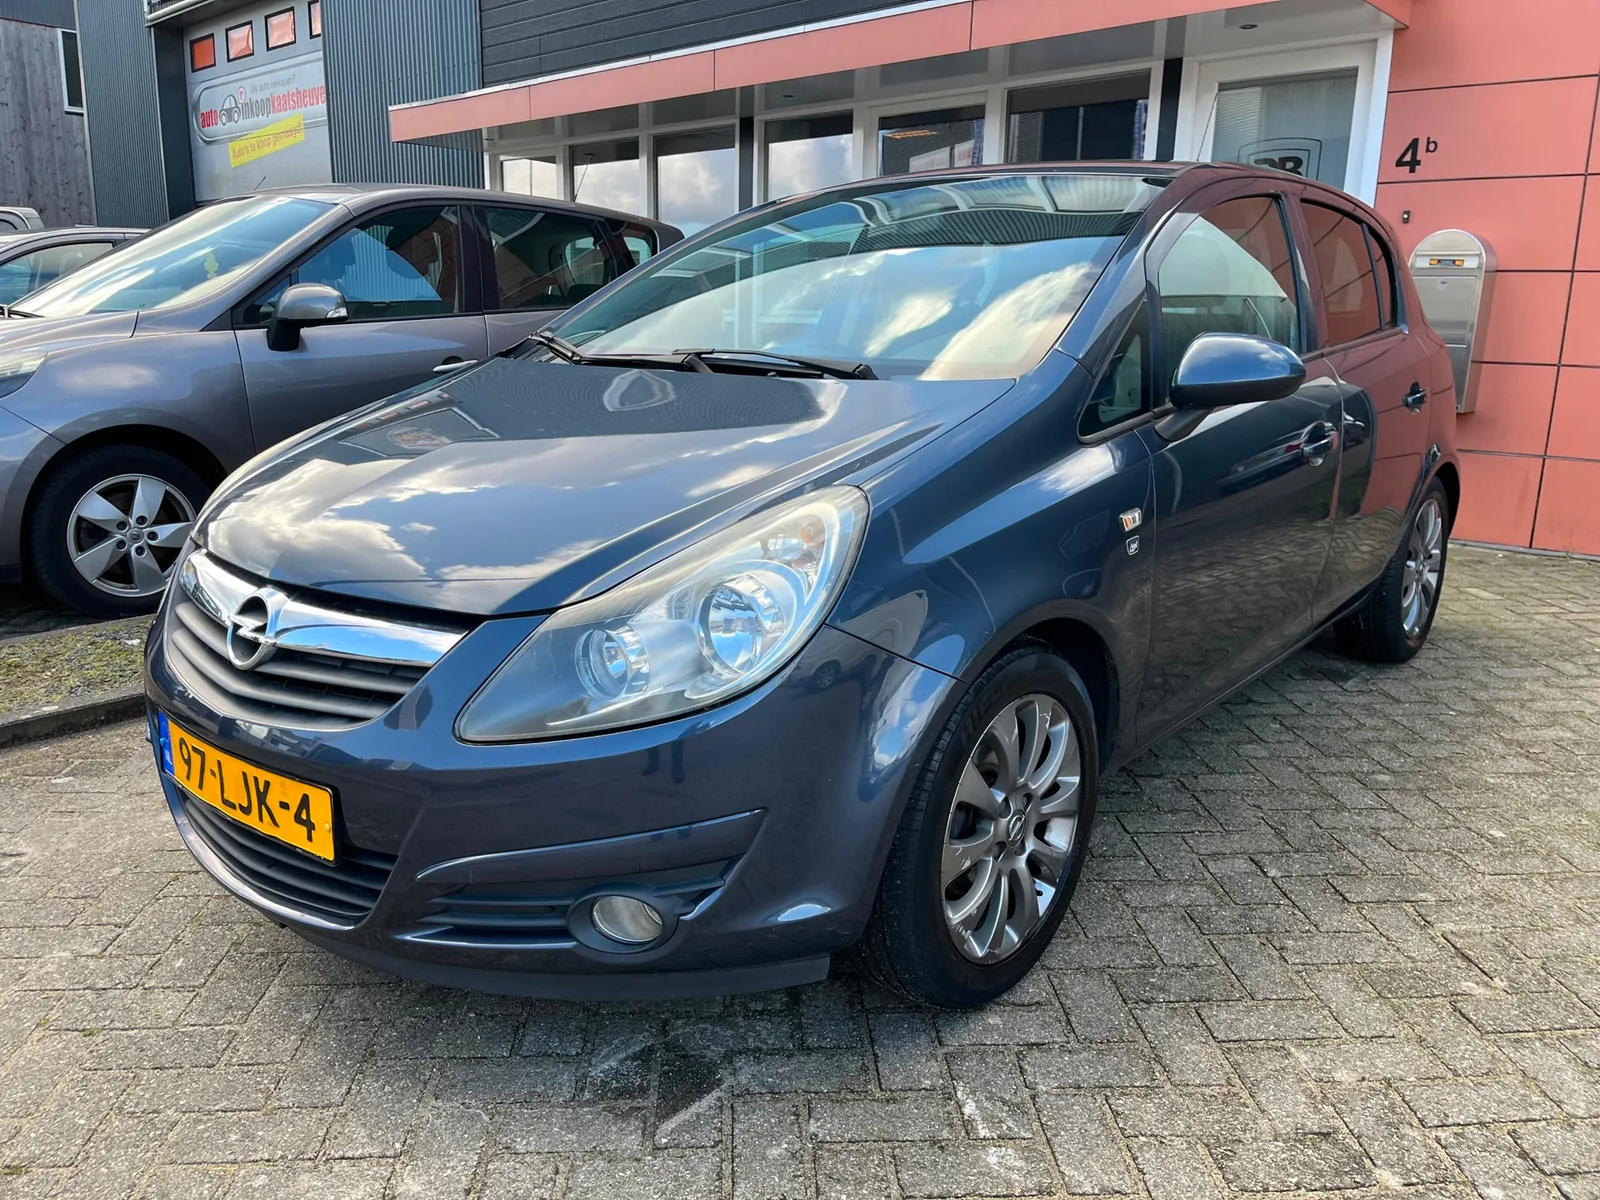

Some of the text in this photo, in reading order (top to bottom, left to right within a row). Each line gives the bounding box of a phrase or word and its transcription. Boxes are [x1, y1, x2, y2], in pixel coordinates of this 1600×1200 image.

[200, 108, 219, 129] auto
[256, 137, 272, 151] koop
[178, 736, 316, 843] 97-LJK-4
